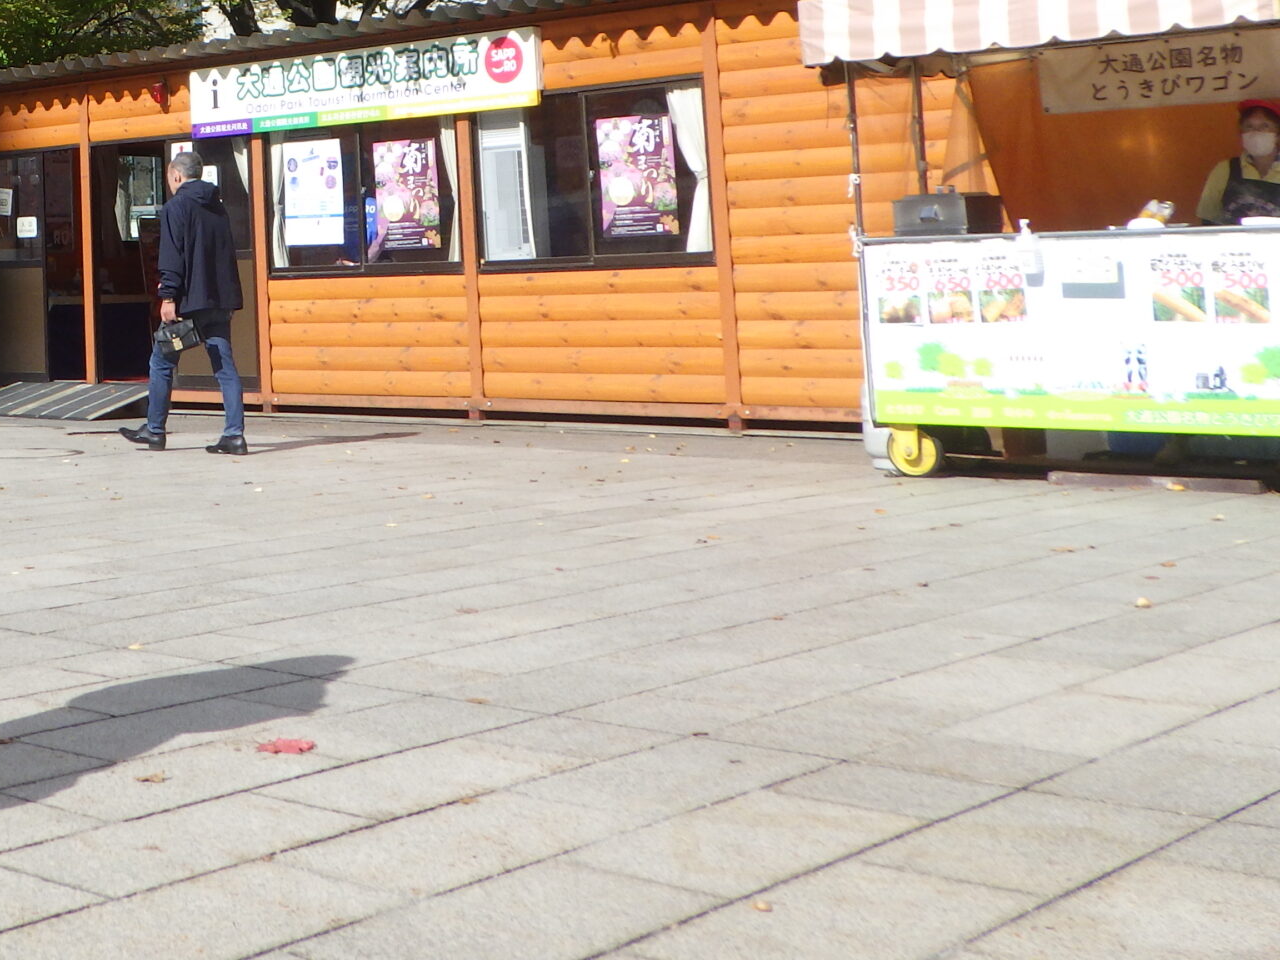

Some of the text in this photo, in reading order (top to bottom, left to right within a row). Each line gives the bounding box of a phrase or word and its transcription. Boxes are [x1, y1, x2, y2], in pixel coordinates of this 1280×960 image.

[491, 48, 516, 62] SAPP
[1098, 44, 1243, 76] 大通公園名物
[1092, 72, 1260, 101] とうきびワゴン
[280, 99, 303, 110] Park
[308, 95, 345, 108] Tourist
[348, 87, 420, 104] Information
[424, 81, 468, 96] Center
[885, 275, 920, 291] 350
[935, 276, 971, 292] 650
[986, 273, 1023, 289] 600
[1160, 271, 1204, 287] 500
[1224, 272, 1268, 288] 500
